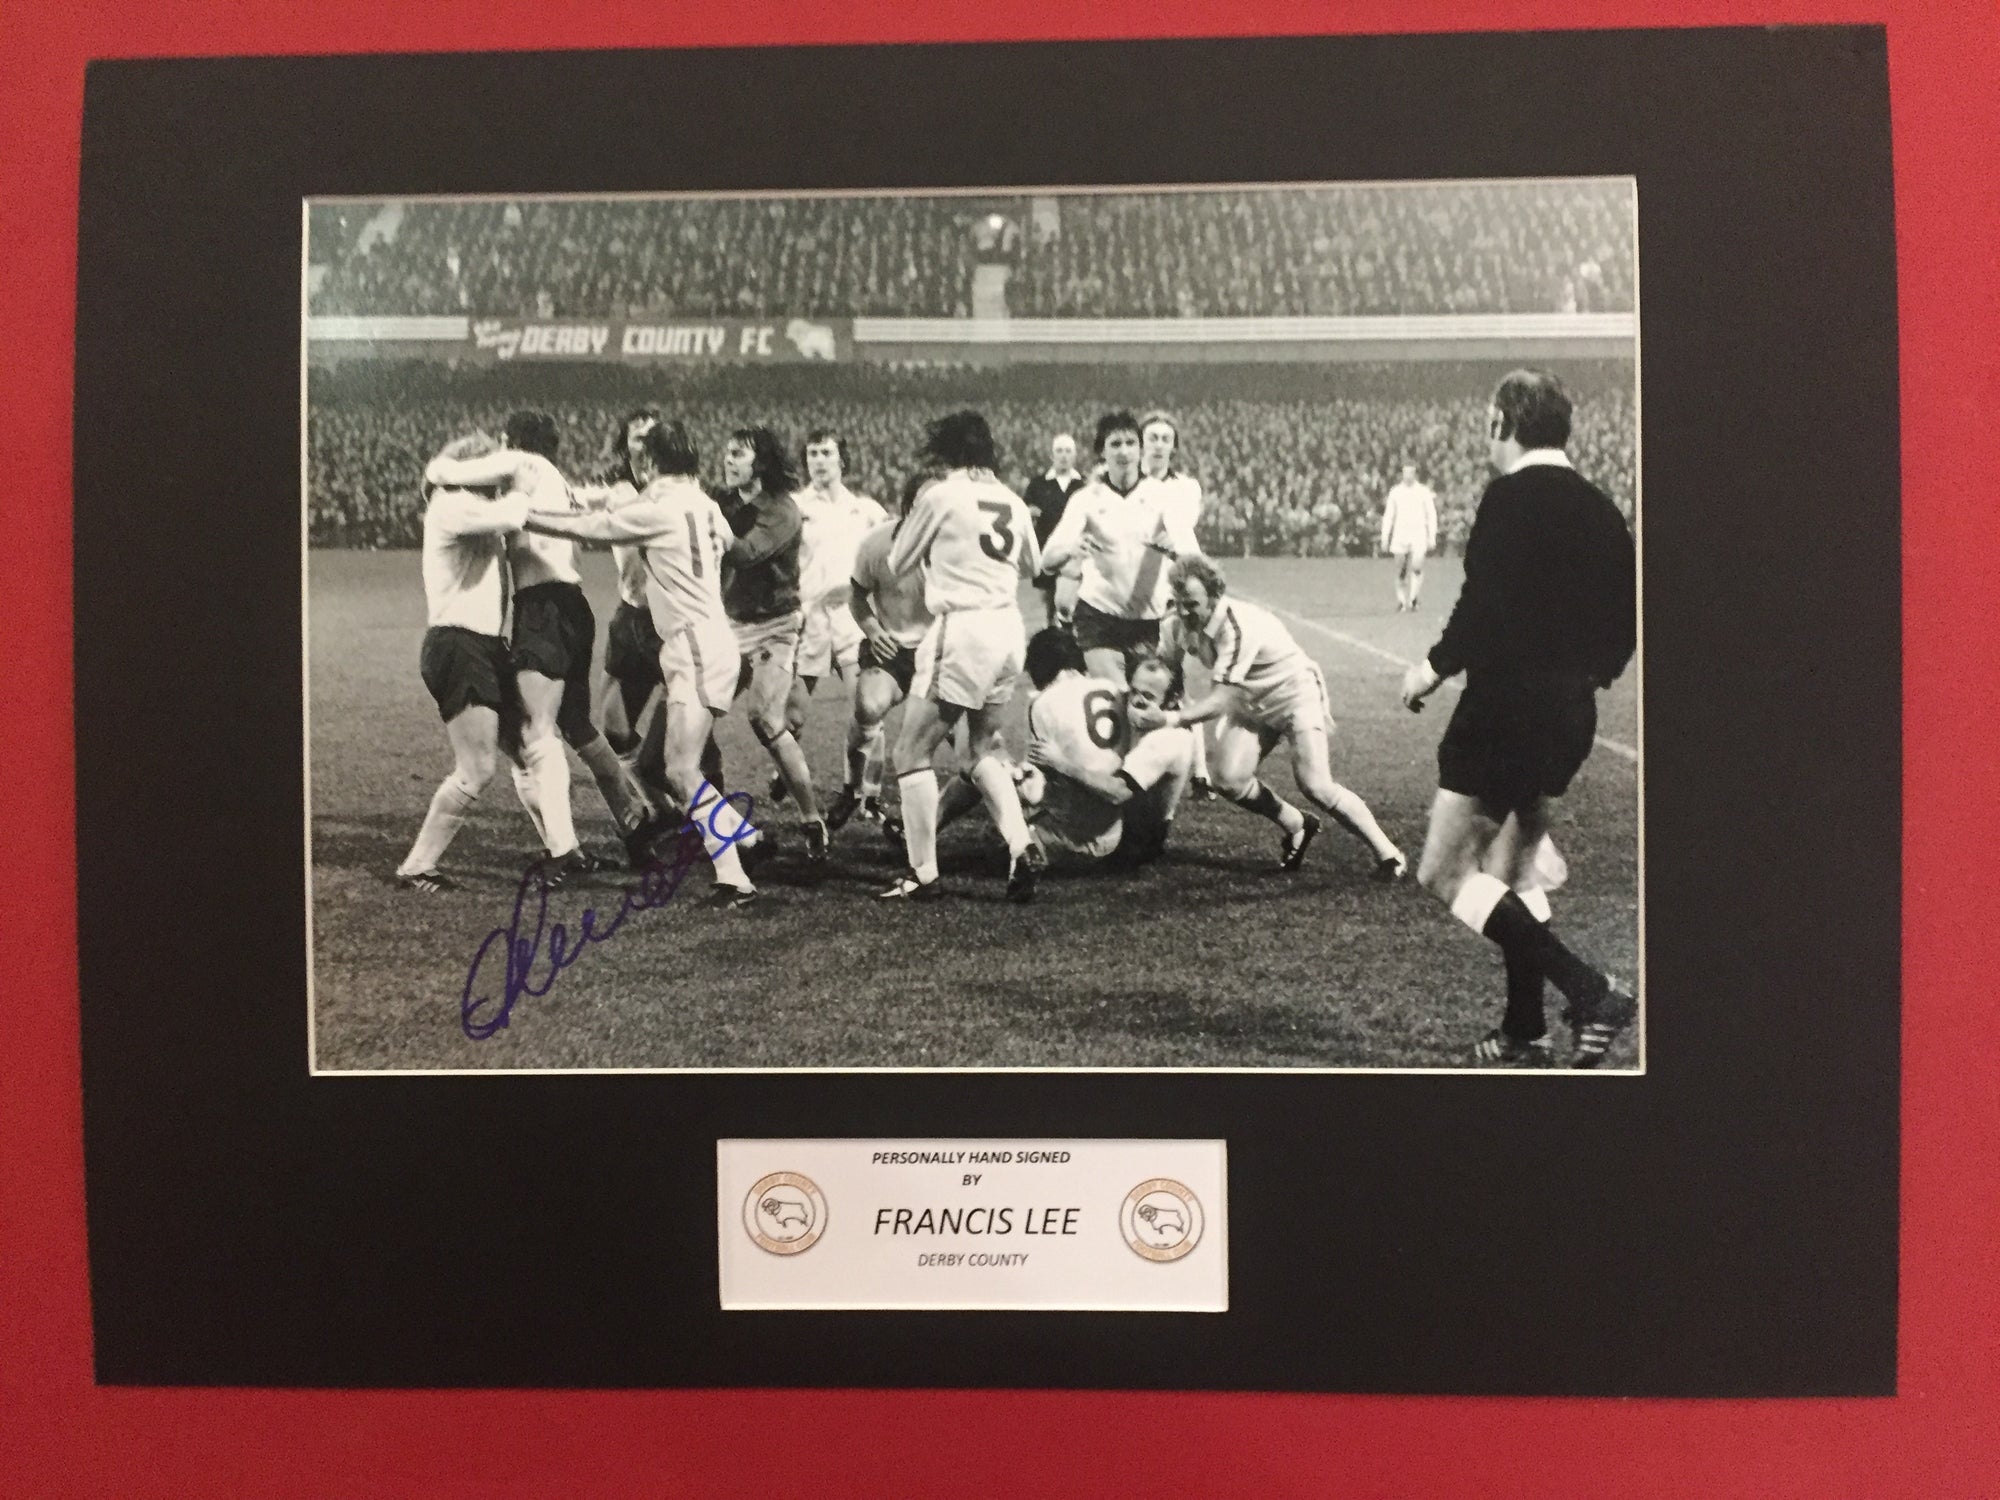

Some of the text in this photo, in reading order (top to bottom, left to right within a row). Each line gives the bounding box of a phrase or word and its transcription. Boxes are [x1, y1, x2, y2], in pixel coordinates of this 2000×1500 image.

[520, 325, 775, 356] DERBY COUNTY FC
[977, 500, 1015, 562] 3
[1083, 690, 1121, 749] 6
[872, 1151, 1071, 1165] PERSONALLY HAND SIGNED
[962, 1174, 982, 1186] BY
[873, 1208, 1081, 1235] FRANCIS LEE
[917, 1253, 1029, 1267] DERBY COUNTY
